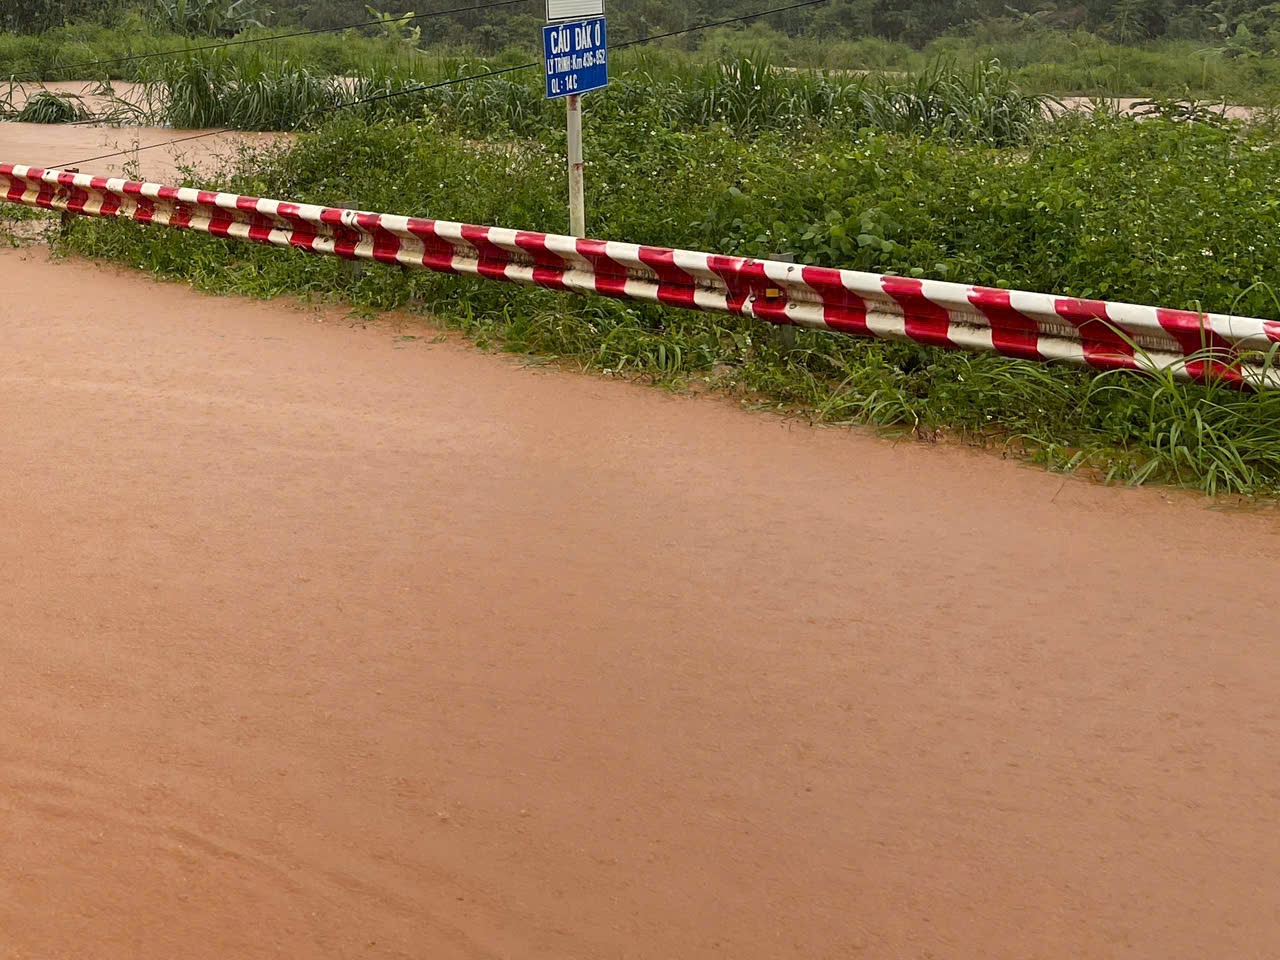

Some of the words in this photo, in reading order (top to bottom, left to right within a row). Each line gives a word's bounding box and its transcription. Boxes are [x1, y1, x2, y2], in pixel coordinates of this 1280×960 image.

[550, 25, 570, 54] CẦU
[547, 55, 554, 75] LÝ
[565, 74, 578, 91] 14C
